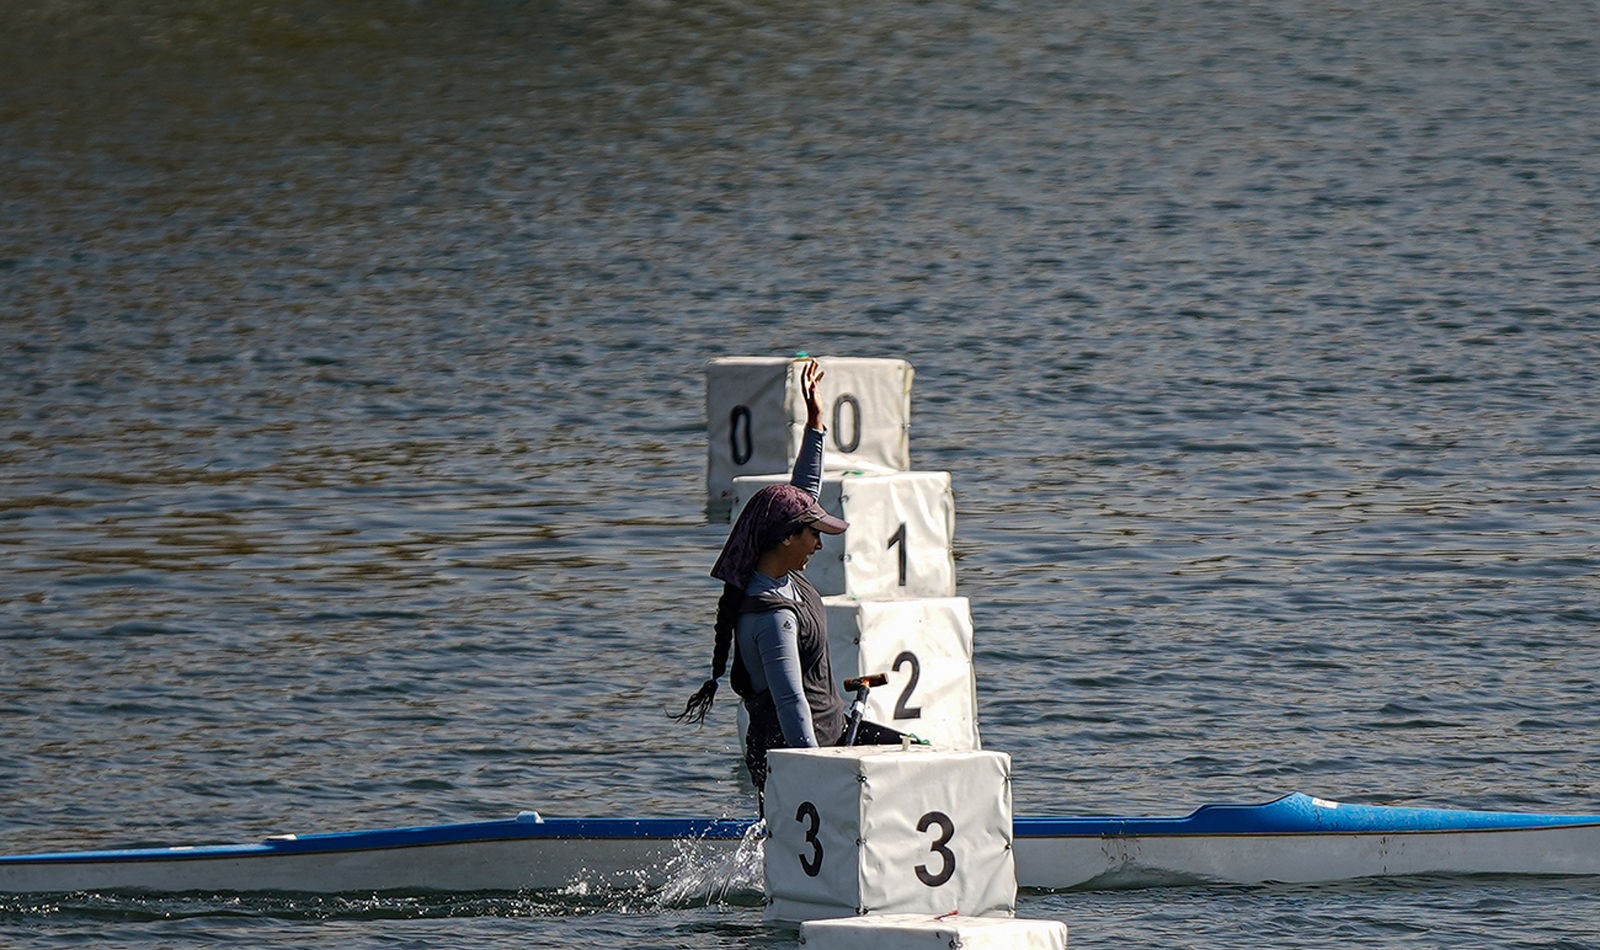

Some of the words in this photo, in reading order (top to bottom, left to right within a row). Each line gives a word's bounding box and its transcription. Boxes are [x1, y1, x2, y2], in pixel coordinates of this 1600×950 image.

[730, 405, 752, 465] 0
[833, 394, 861, 453] 0
[887, 523, 907, 586] 1
[891, 651, 922, 720] 2
[795, 801, 823, 877] 3
[914, 811, 956, 887] 3
